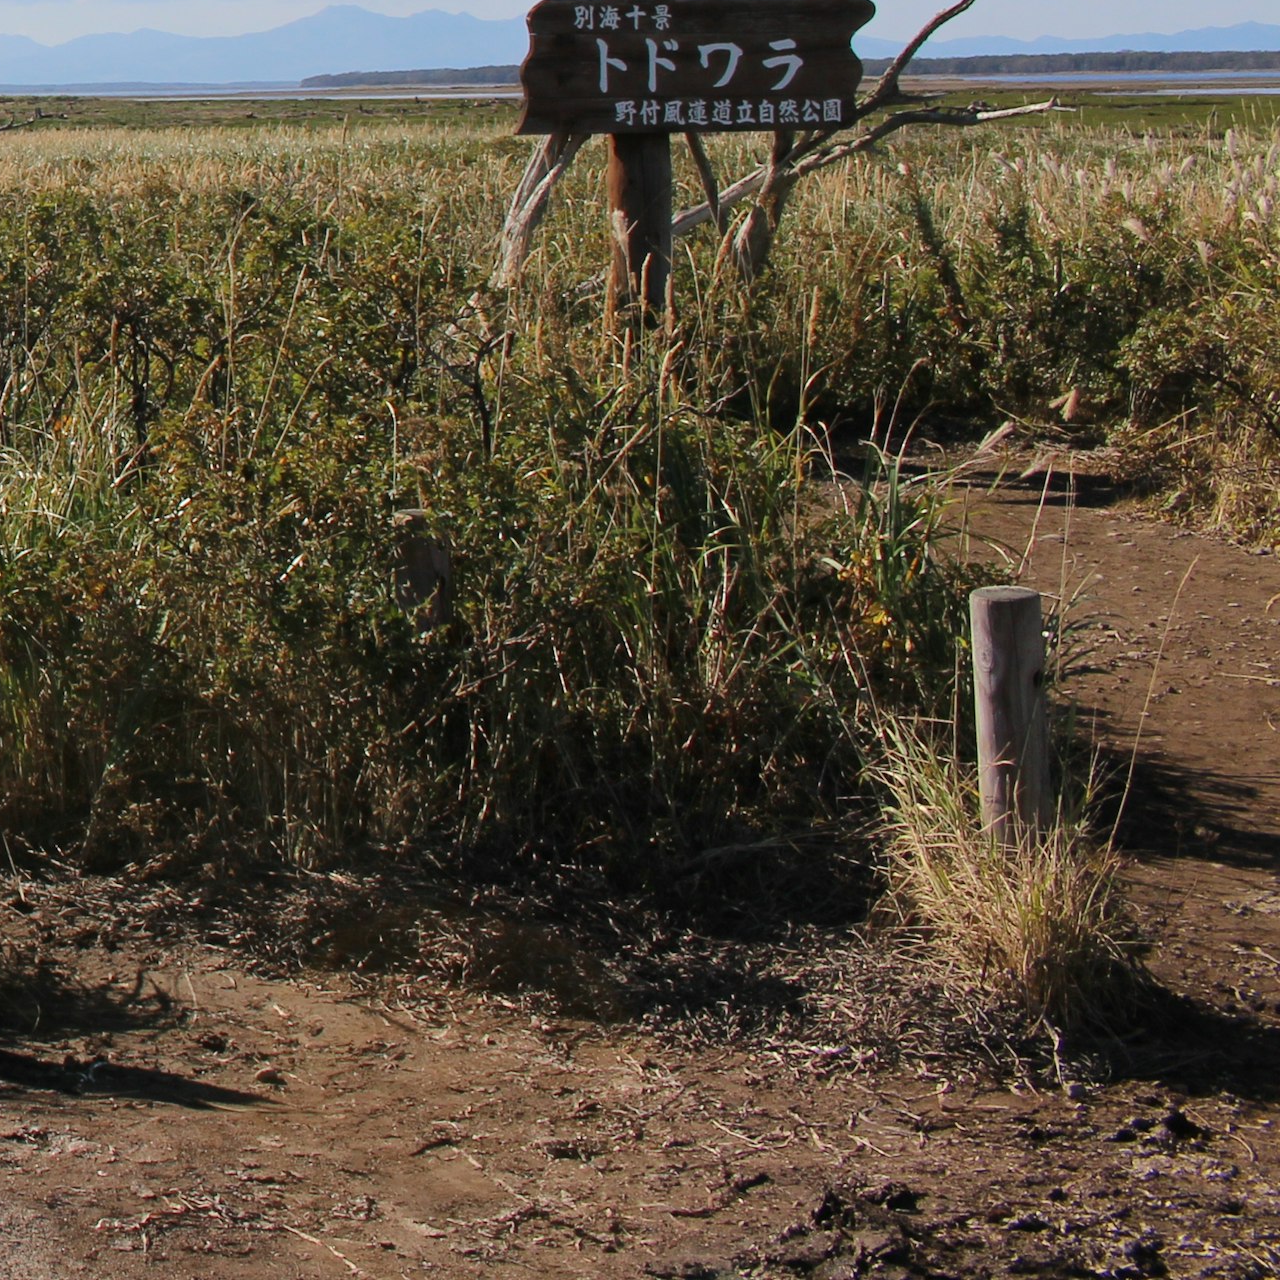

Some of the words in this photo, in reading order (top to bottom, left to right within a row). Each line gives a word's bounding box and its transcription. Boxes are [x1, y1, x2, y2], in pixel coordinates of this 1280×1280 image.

[574, 5, 672, 30] 別海十景
[596, 38, 803, 93] トドワラ
[615, 99, 842, 126] 野付風蓮道立自然公園
